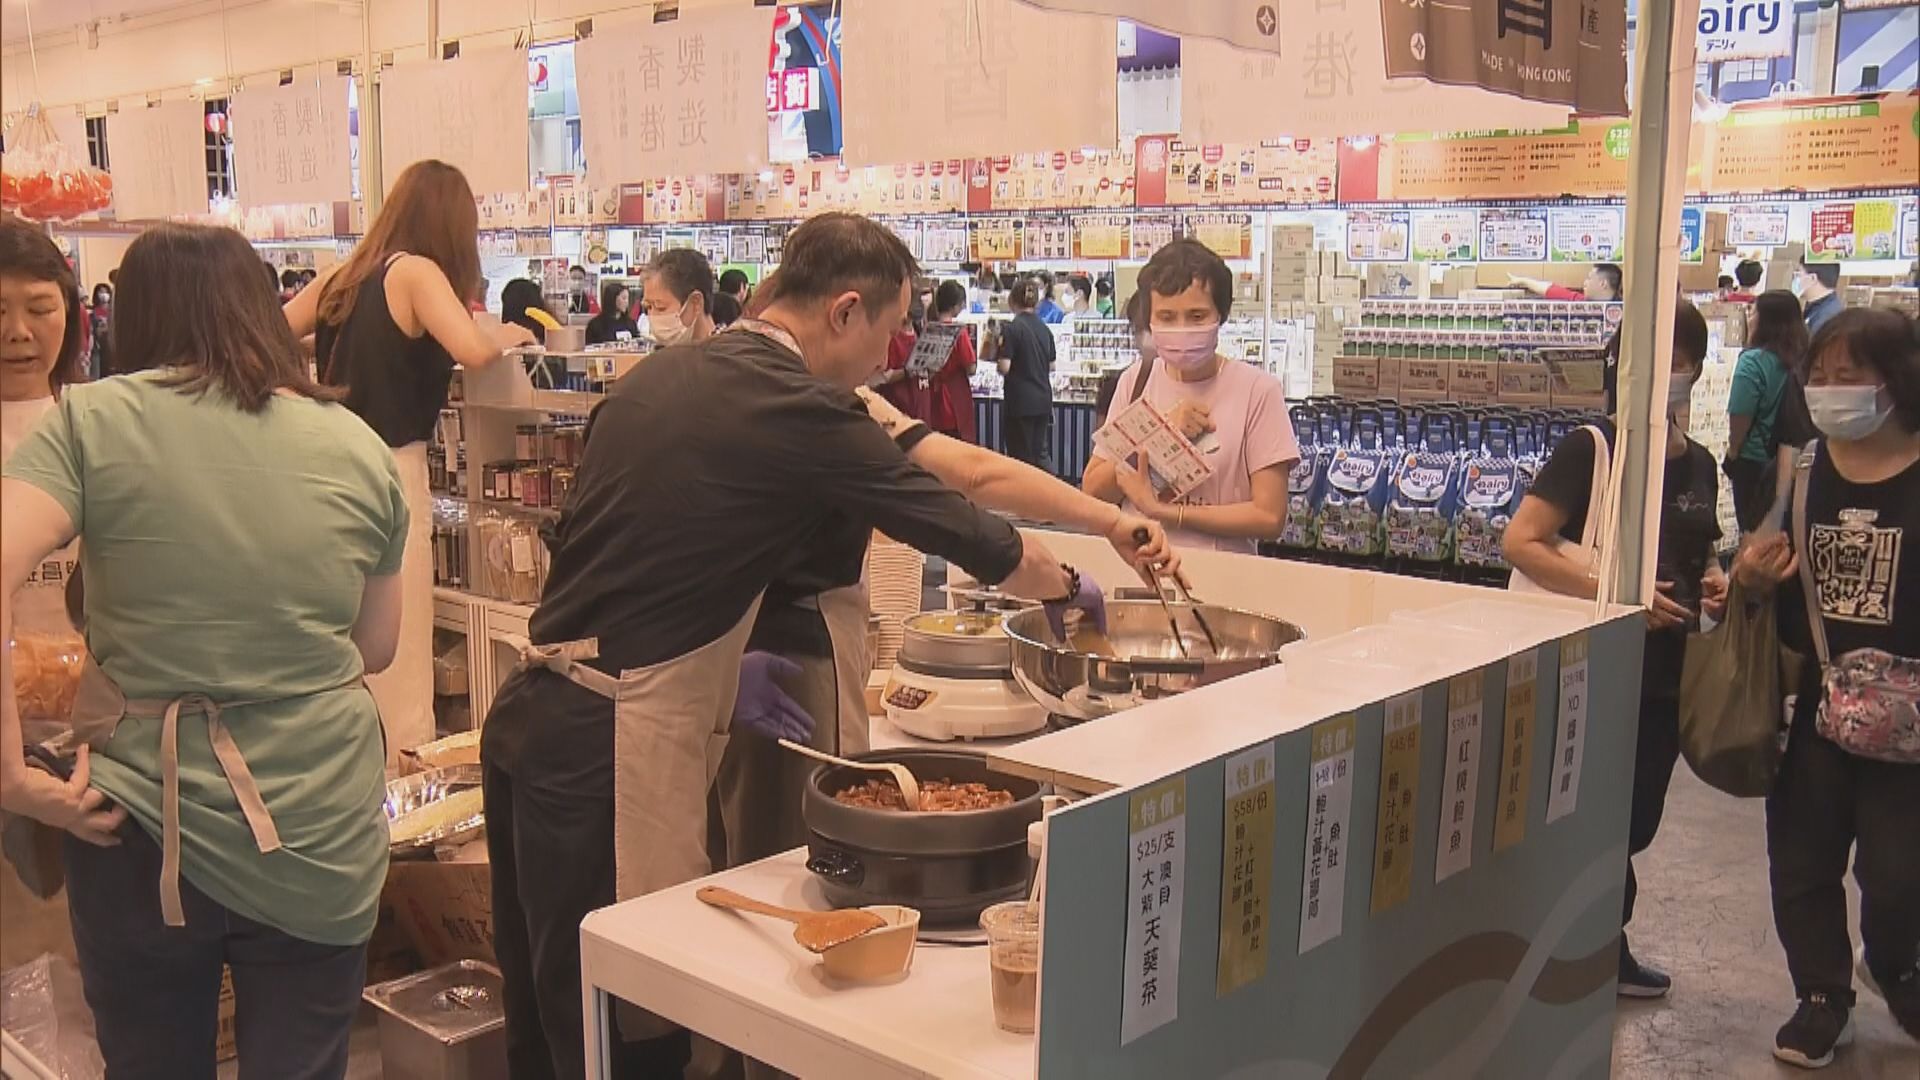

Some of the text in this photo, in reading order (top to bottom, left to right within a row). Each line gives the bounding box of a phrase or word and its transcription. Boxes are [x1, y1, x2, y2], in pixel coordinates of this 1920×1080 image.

[1481, 50, 1503, 72] MADE
[1517, 65, 1540, 81] HONG
[1542, 68, 1572, 83] KONG
[1568, 695, 1580, 712] XO
[1236, 756, 1267, 790] 特價
[1140, 789, 1177, 827] 特價
[1234, 790, 1268, 820] $58/份
[1136, 830, 1176, 862] $25/支
